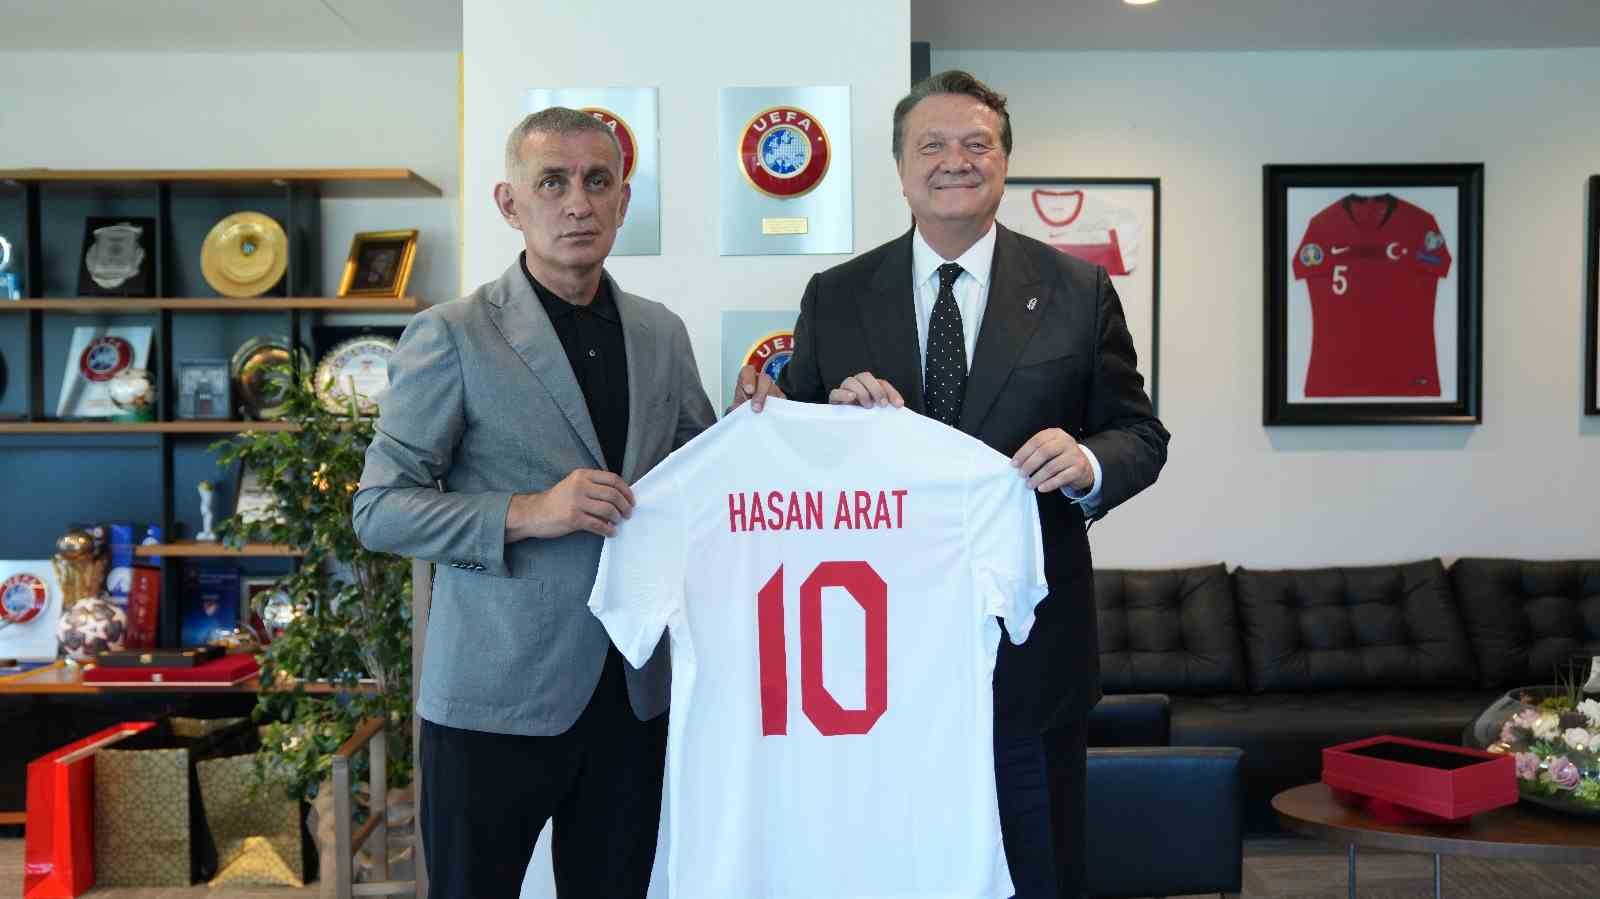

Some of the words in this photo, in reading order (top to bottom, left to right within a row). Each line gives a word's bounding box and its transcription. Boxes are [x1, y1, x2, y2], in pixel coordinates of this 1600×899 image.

[753, 111, 811, 132] UEFA
[1332, 265, 1348, 295] 5
[757, 337, 794, 358] UE
[728, 490, 824, 532] HASAN
[834, 489, 908, 530] ARAT
[757, 560, 887, 736] 10
